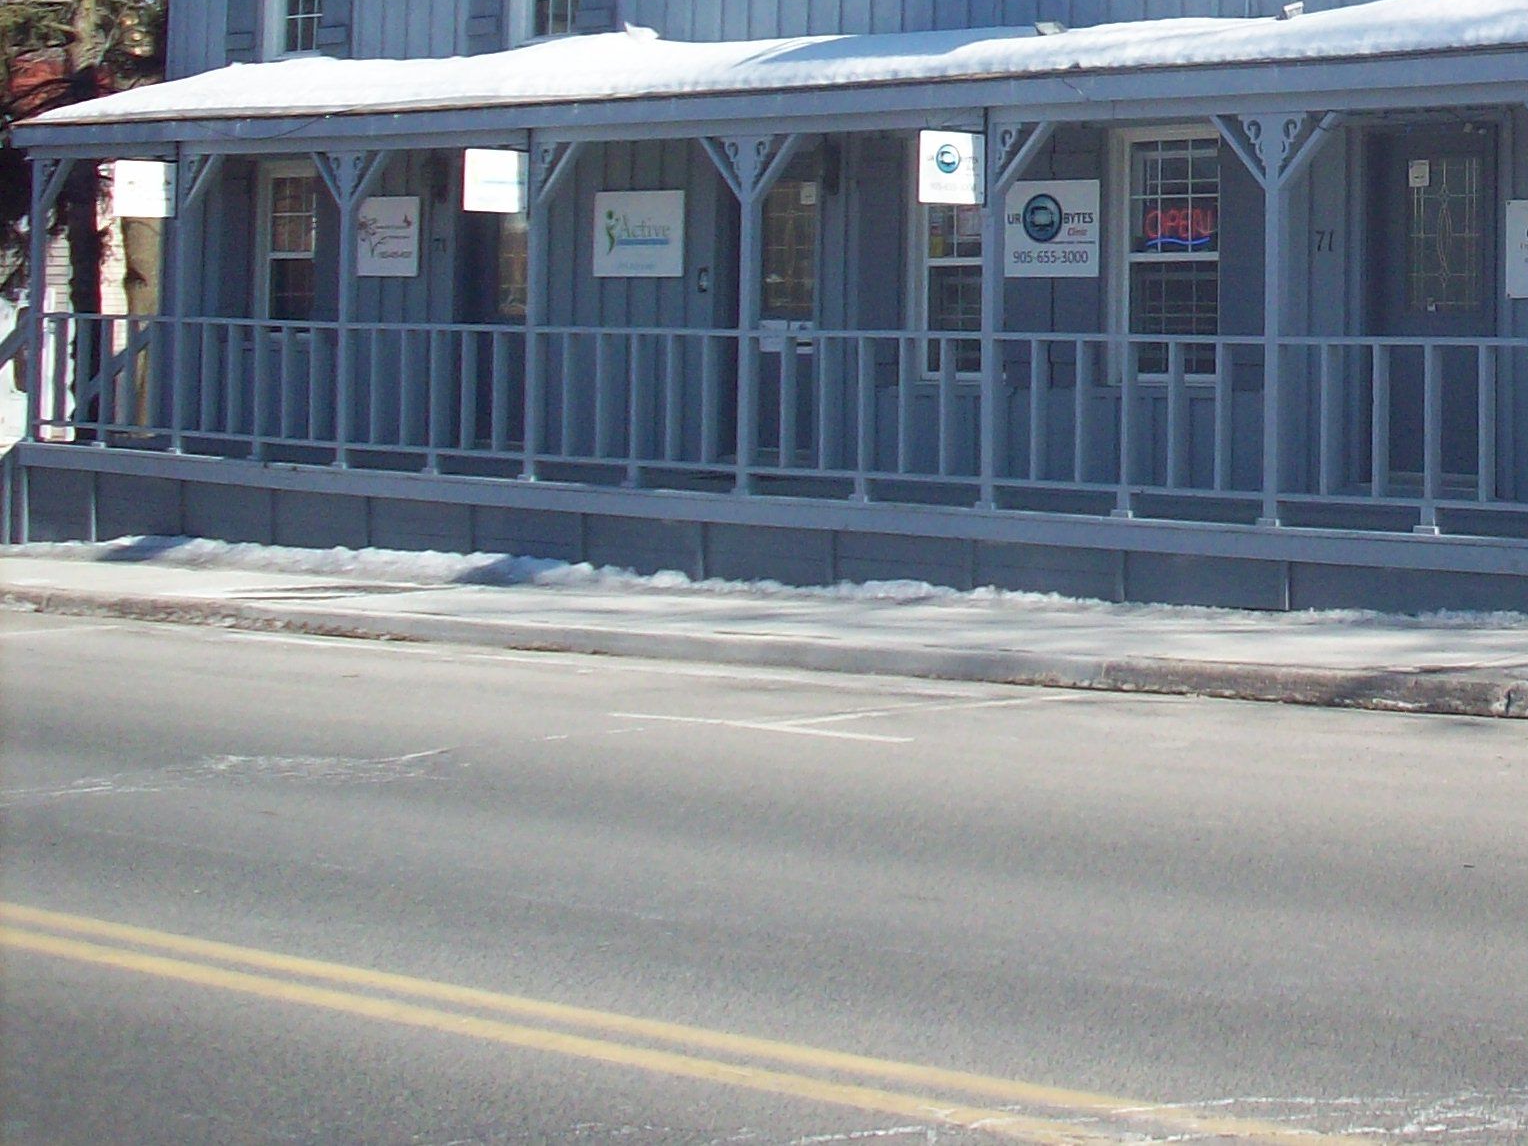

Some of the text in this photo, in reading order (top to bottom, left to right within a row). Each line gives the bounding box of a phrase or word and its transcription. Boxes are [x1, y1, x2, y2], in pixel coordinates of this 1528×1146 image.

[1063, 212, 1094, 224] BYTES
[1144, 207, 1213, 238] OPEN
[1315, 229, 1334, 252] 71
[1013, 250, 1089, 264] 905-655-3000
